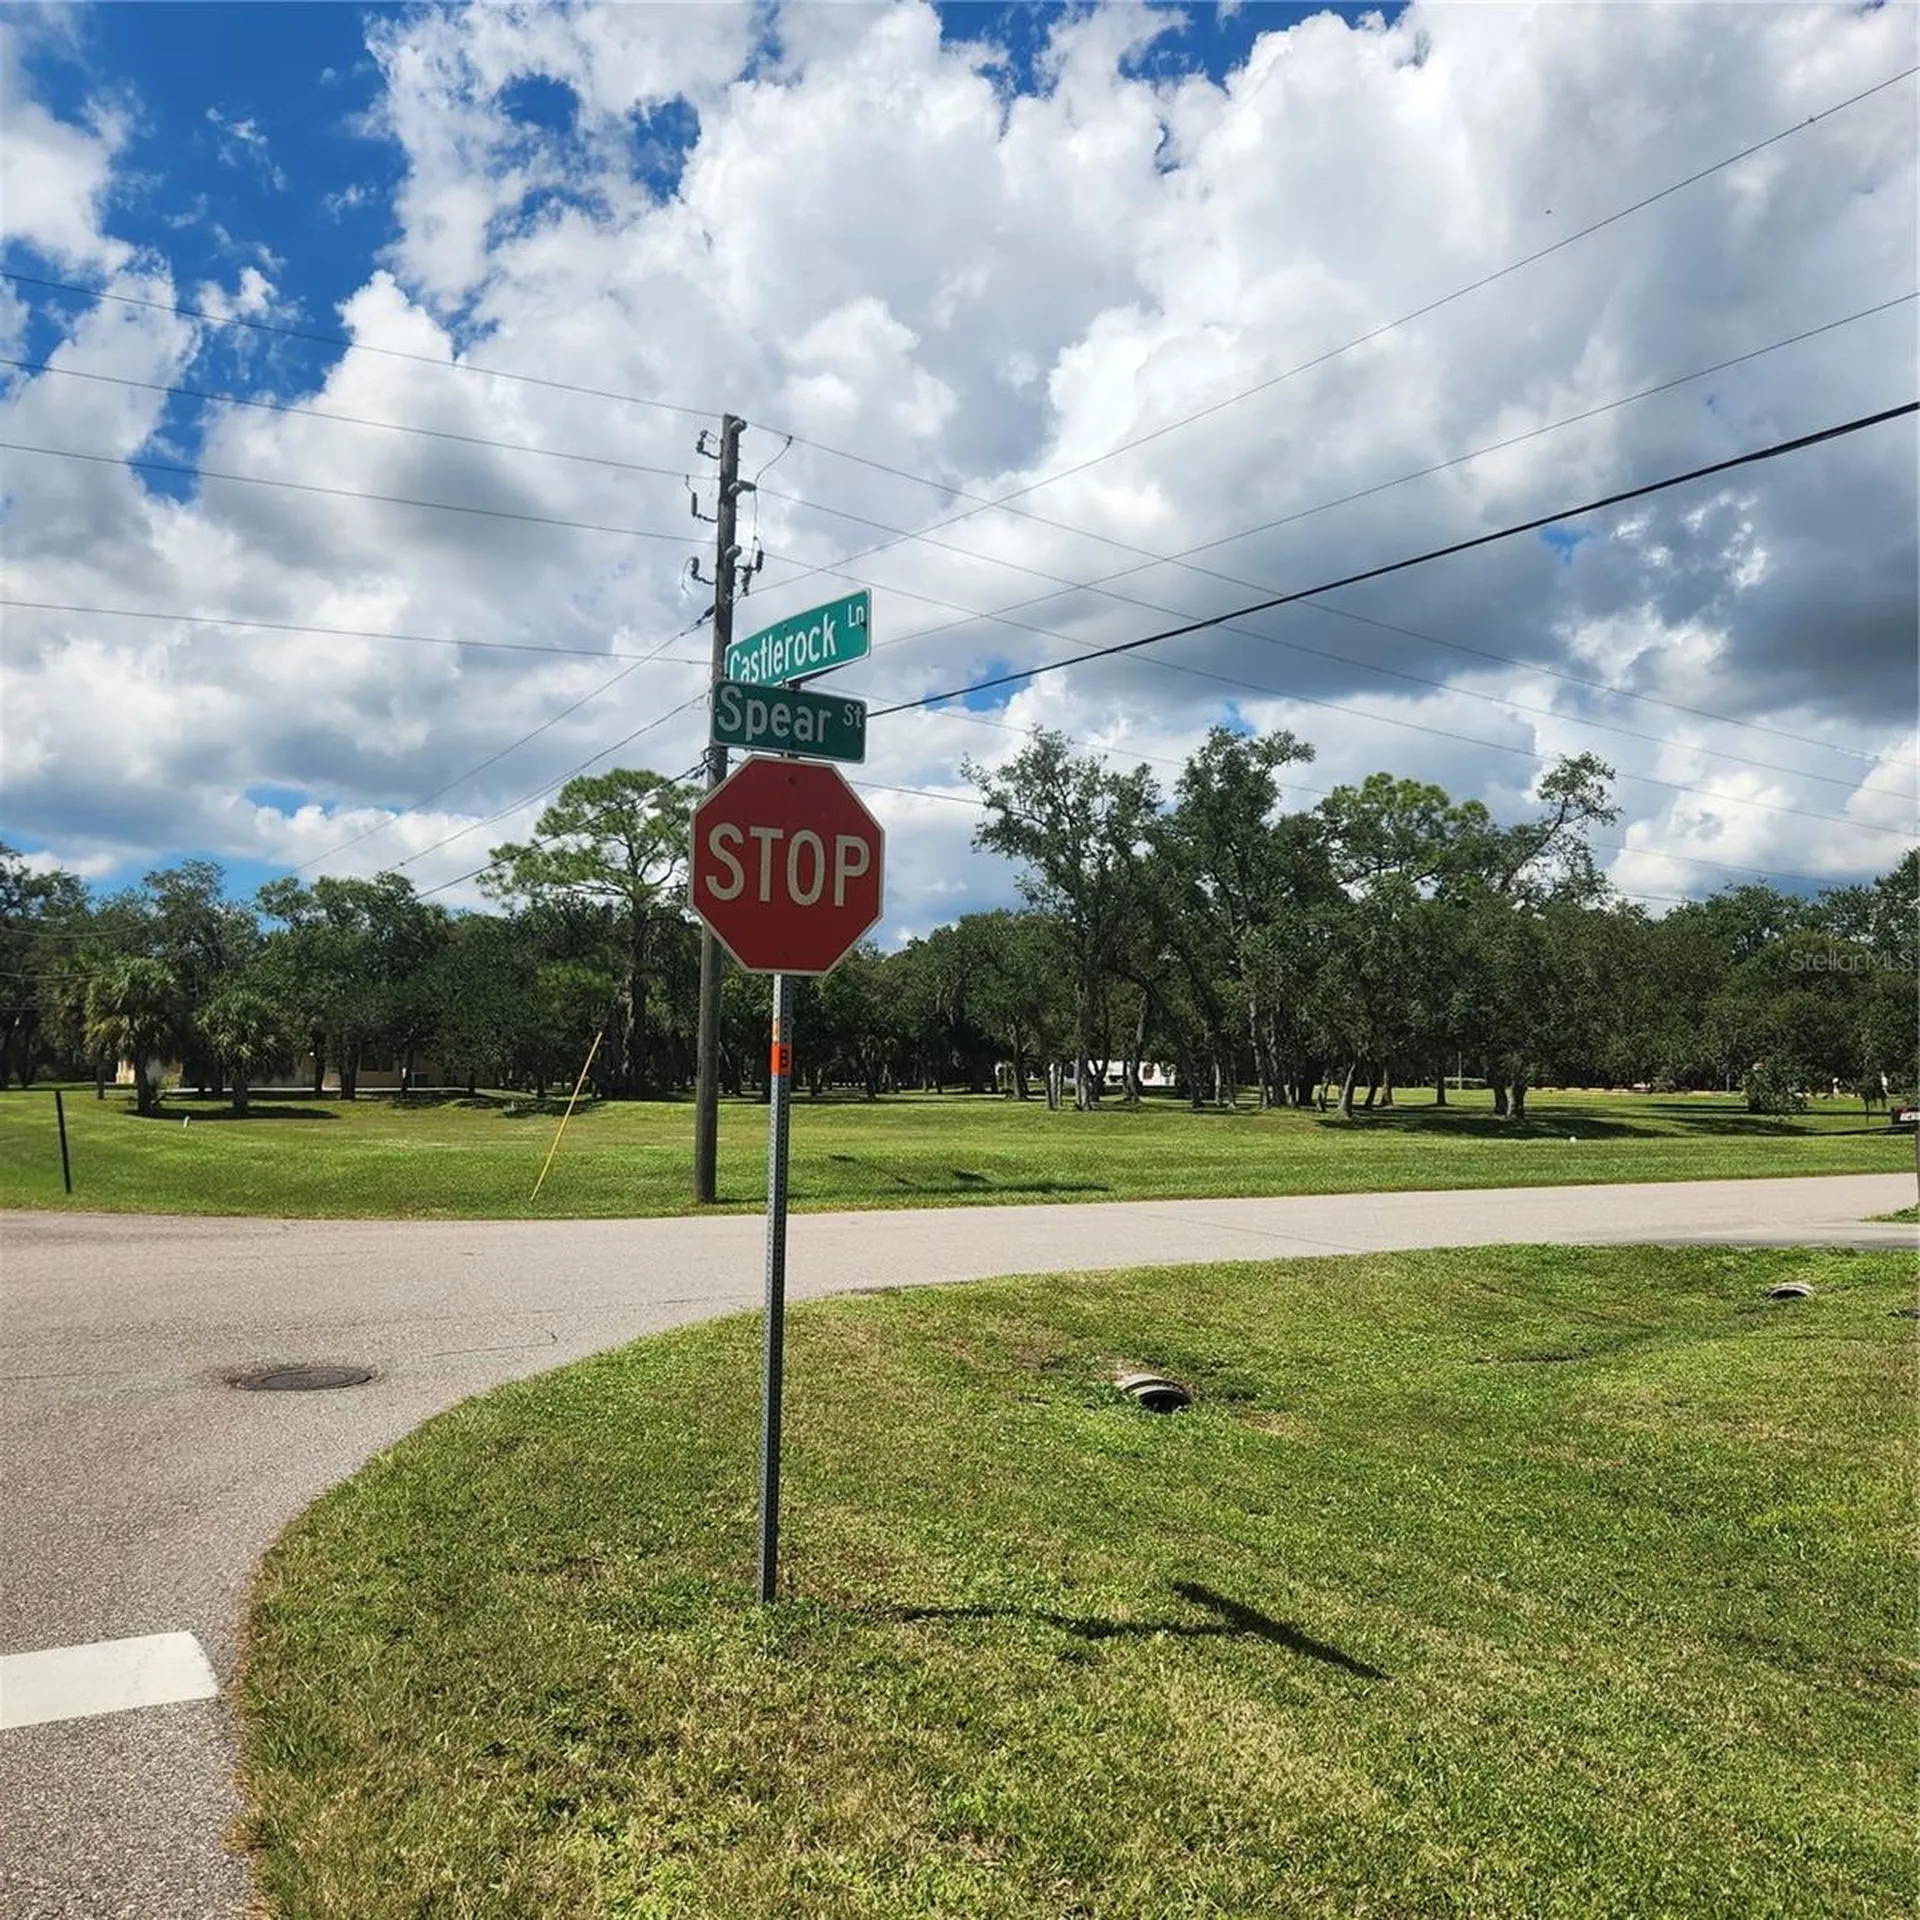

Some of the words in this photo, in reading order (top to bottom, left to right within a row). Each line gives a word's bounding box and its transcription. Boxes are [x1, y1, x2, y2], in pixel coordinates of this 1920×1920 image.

[729, 612, 837, 684] Castlerock
[848, 604, 864, 627] Ln
[717, 685, 832, 743] Spear
[843, 703, 863, 728] St
[705, 822, 870, 907] STOP
